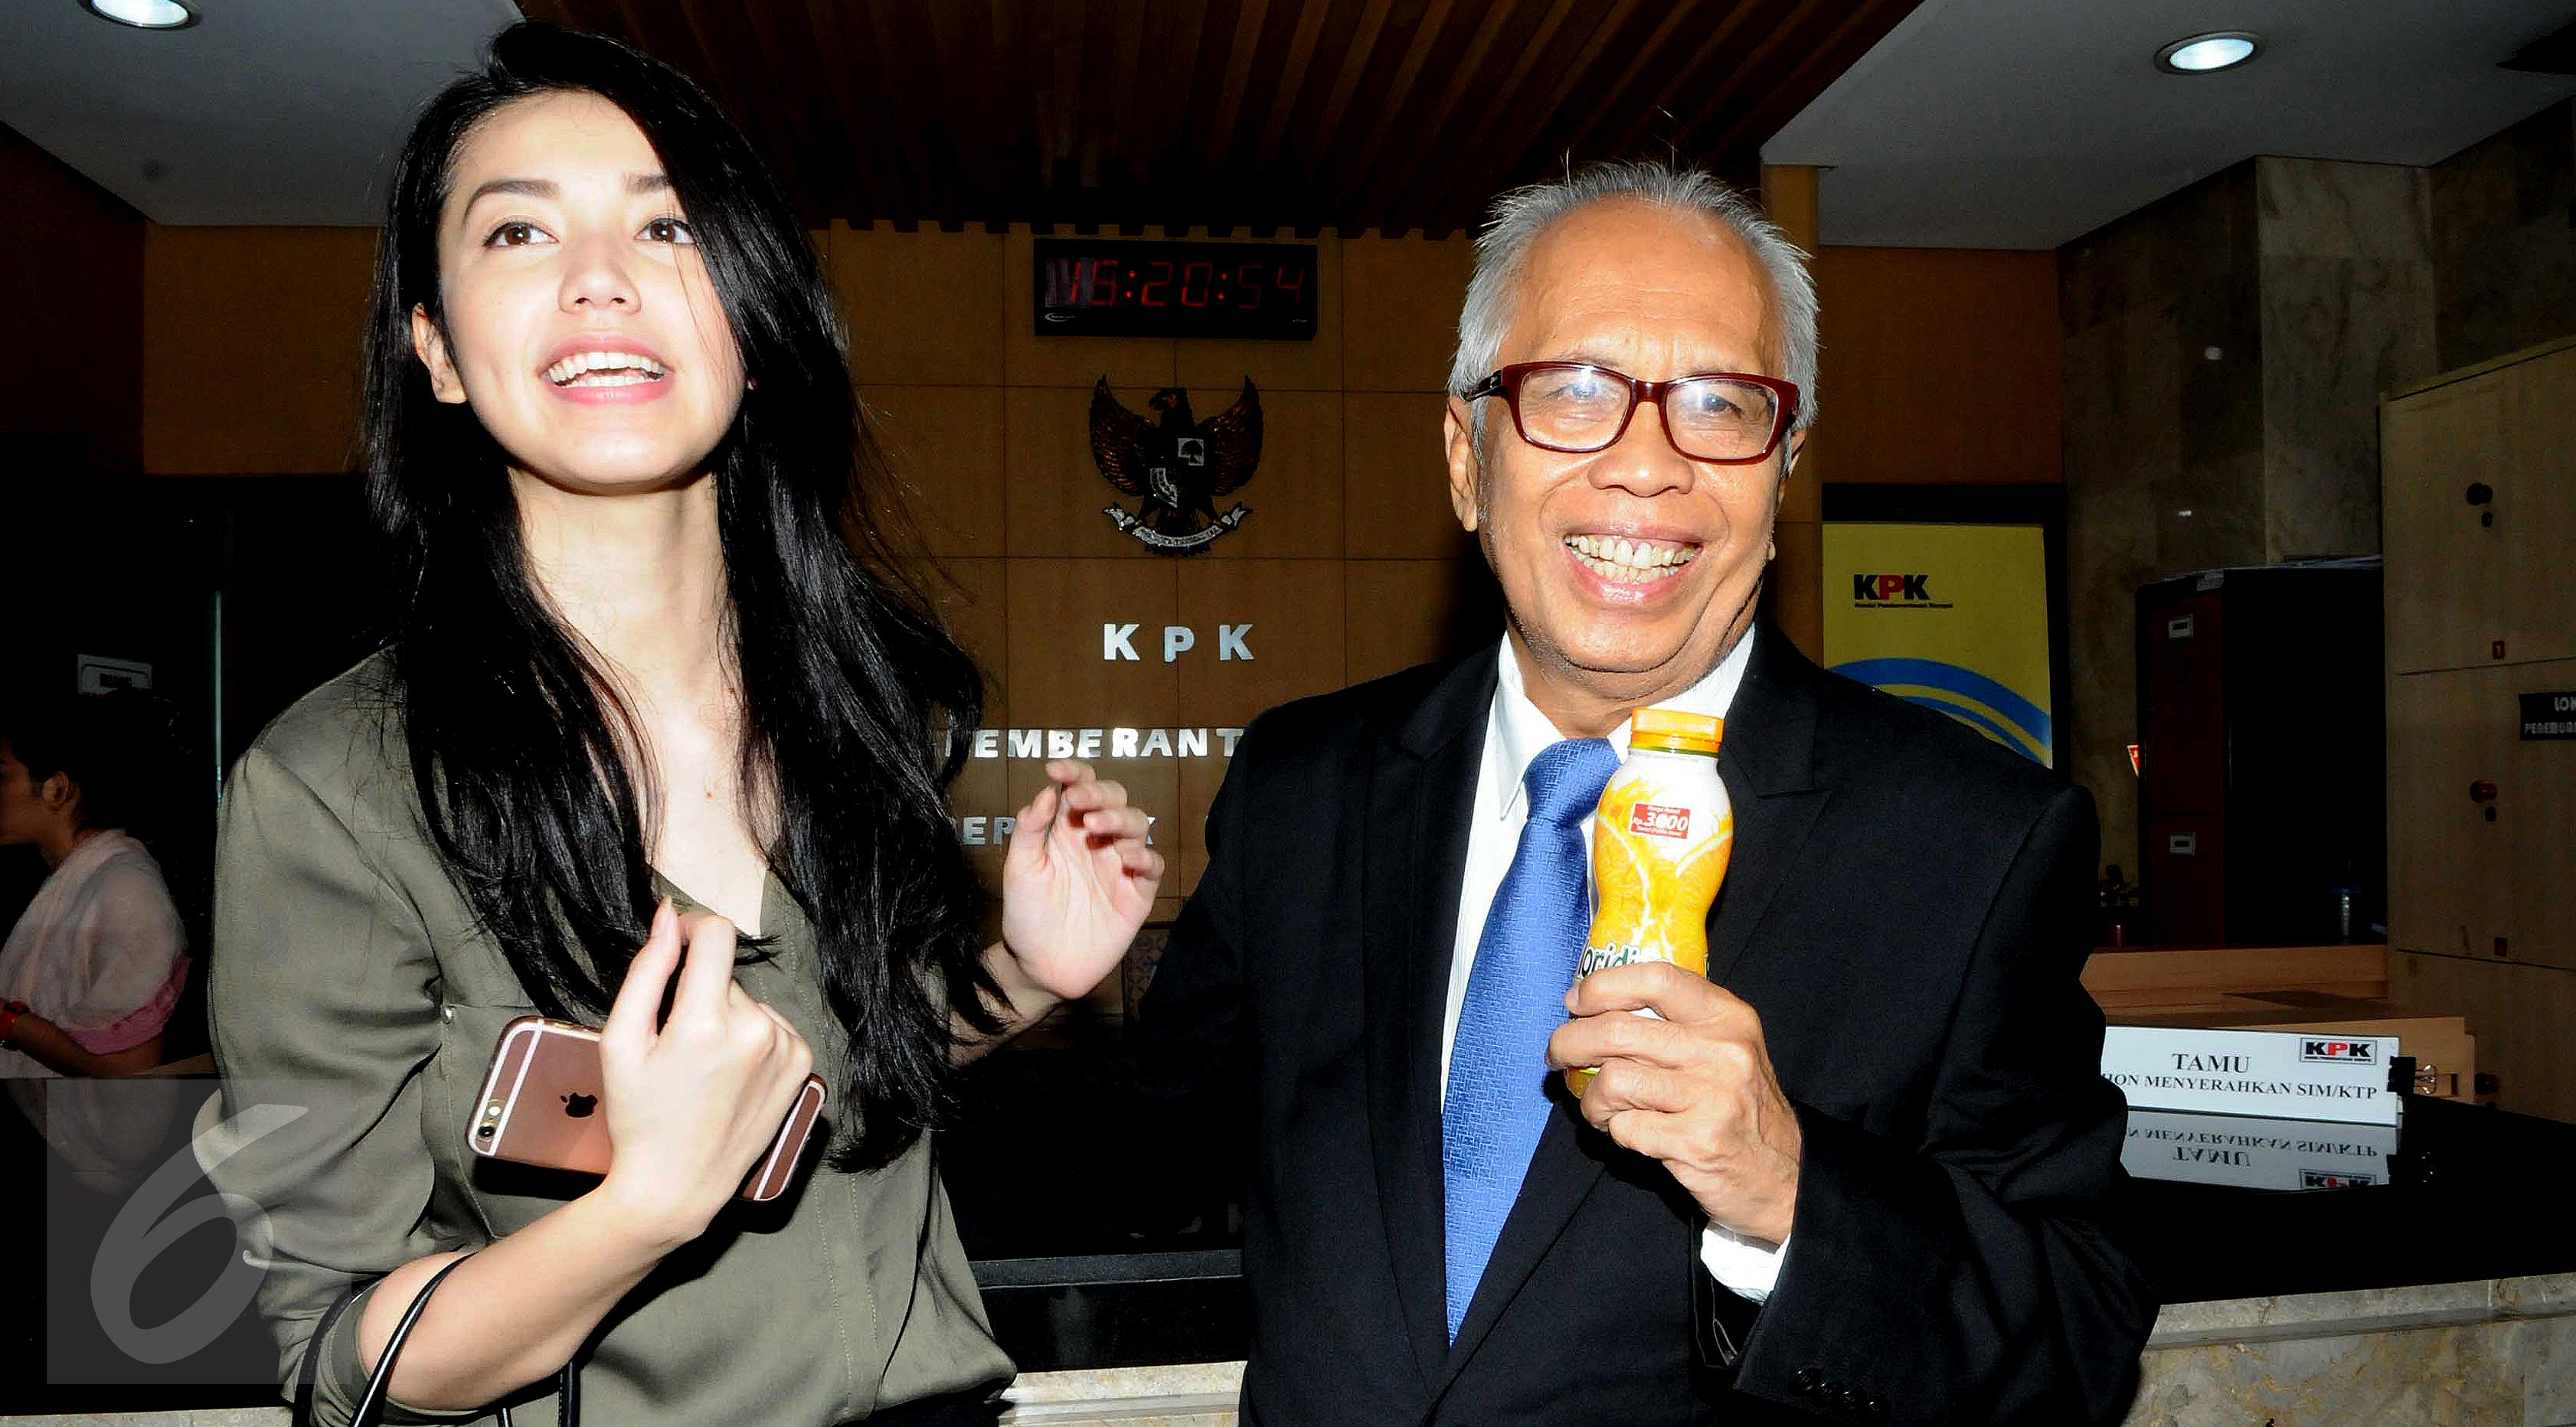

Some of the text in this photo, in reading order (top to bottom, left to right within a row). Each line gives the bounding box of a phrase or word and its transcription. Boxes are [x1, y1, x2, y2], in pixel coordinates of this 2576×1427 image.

[1853, 574, 1930, 600] KPK
[944, 727, 1244, 759] EMBERANT
[2305, 1041, 2371, 1058] KPK
[2172, 1052, 2251, 1073] TAMU
[2145, 1076, 2291, 1096] MENYERAHKAN
[2296, 1084, 2377, 1100] SIM/KTP
